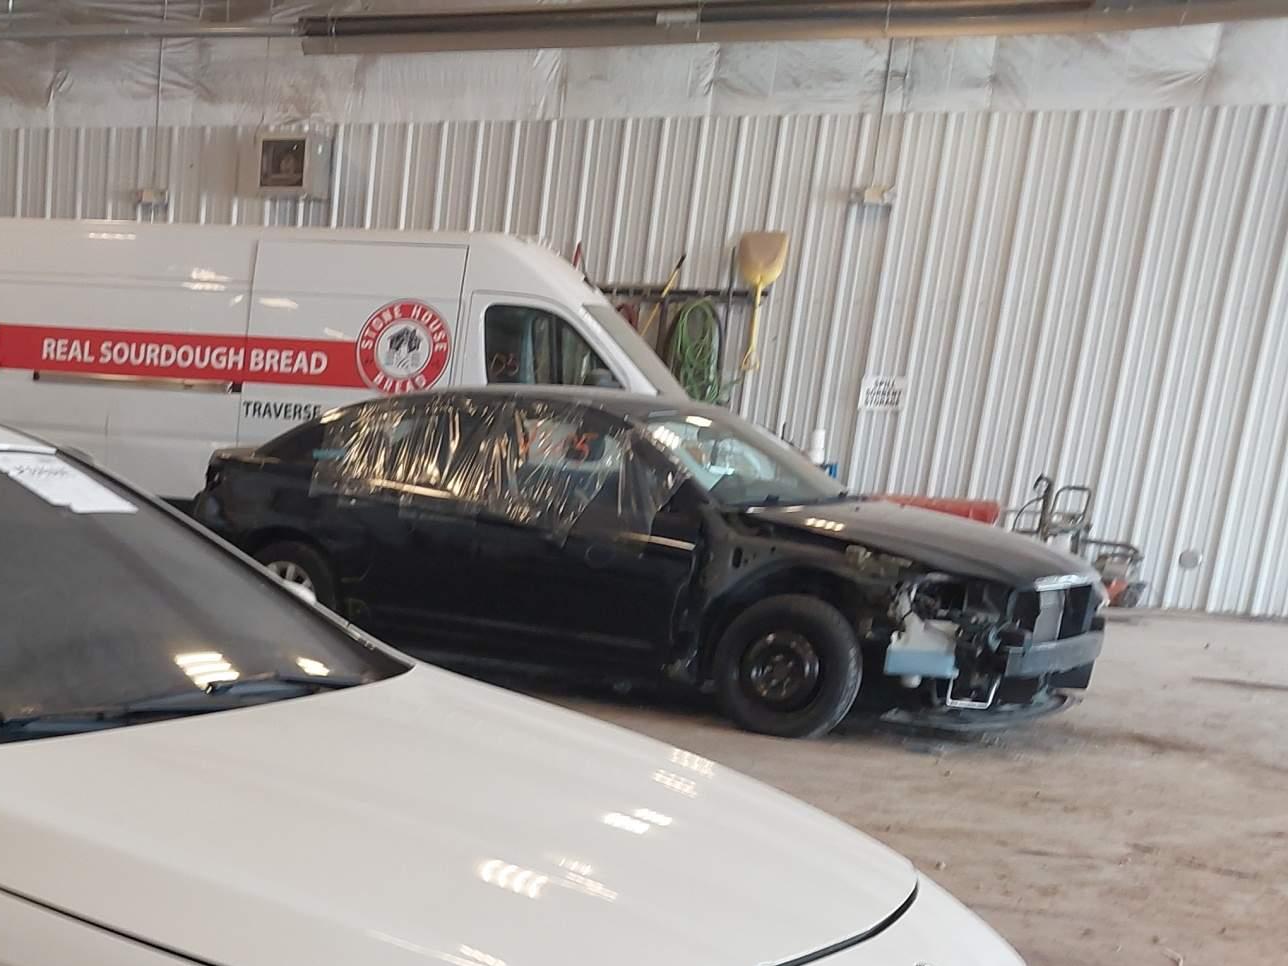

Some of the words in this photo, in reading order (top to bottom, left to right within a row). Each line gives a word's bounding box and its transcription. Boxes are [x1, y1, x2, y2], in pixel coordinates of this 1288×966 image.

[361, 304, 403, 350] STONE
[410, 304, 448, 353] HOUSE
[41, 337, 95, 362] REAL
[99, 340, 244, 370] SOURDOUGH
[249, 350, 328, 375] BREAD
[242, 400, 322, 420] TRAVERSE
